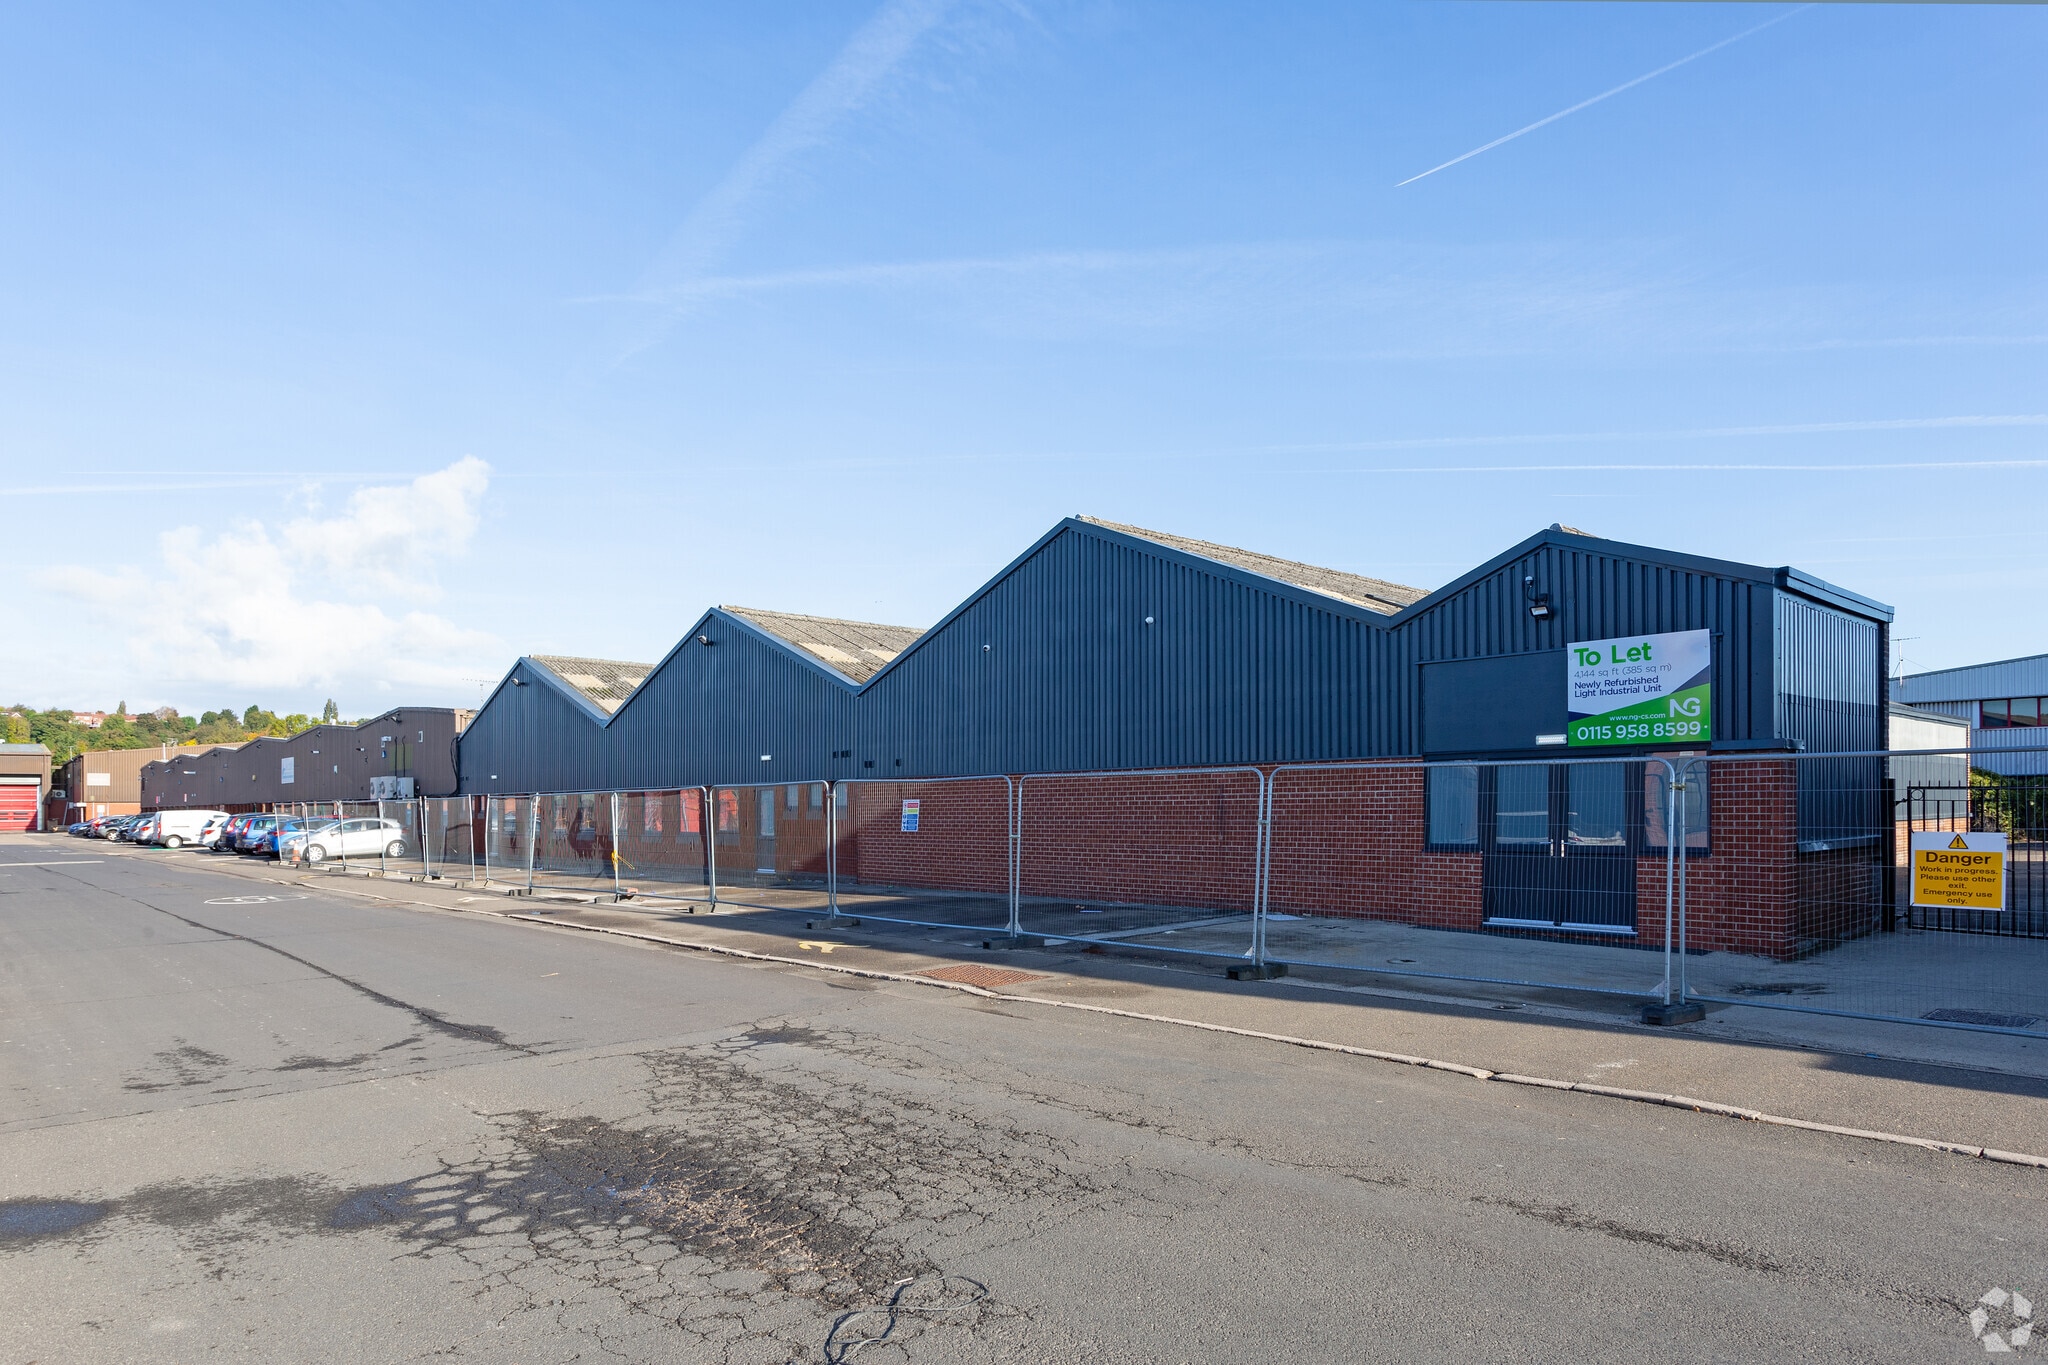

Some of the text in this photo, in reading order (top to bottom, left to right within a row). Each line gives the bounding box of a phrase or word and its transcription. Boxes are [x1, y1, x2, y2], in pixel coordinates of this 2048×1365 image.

[1574, 642, 1652, 666] To Let
[1598, 670, 1609, 678] sq
[1612, 667, 1619, 675] ft
[1622, 665, 1642, 676] (385
[1660, 663, 1672, 672] m)
[1574, 675, 1659, 690] Newly Refurbished
[1574, 684, 1662, 698] Light Industrial Unit
[1669, 697, 1700, 718] NG
[1609, 712, 1666, 722] www.ng-cs.com
[1577, 721, 1700, 740] 0115 958 8599
[1926, 852, 1991, 866] Danger
[1955, 867, 1998, 875] progress.
[1923, 889, 1973, 897] Emergency
